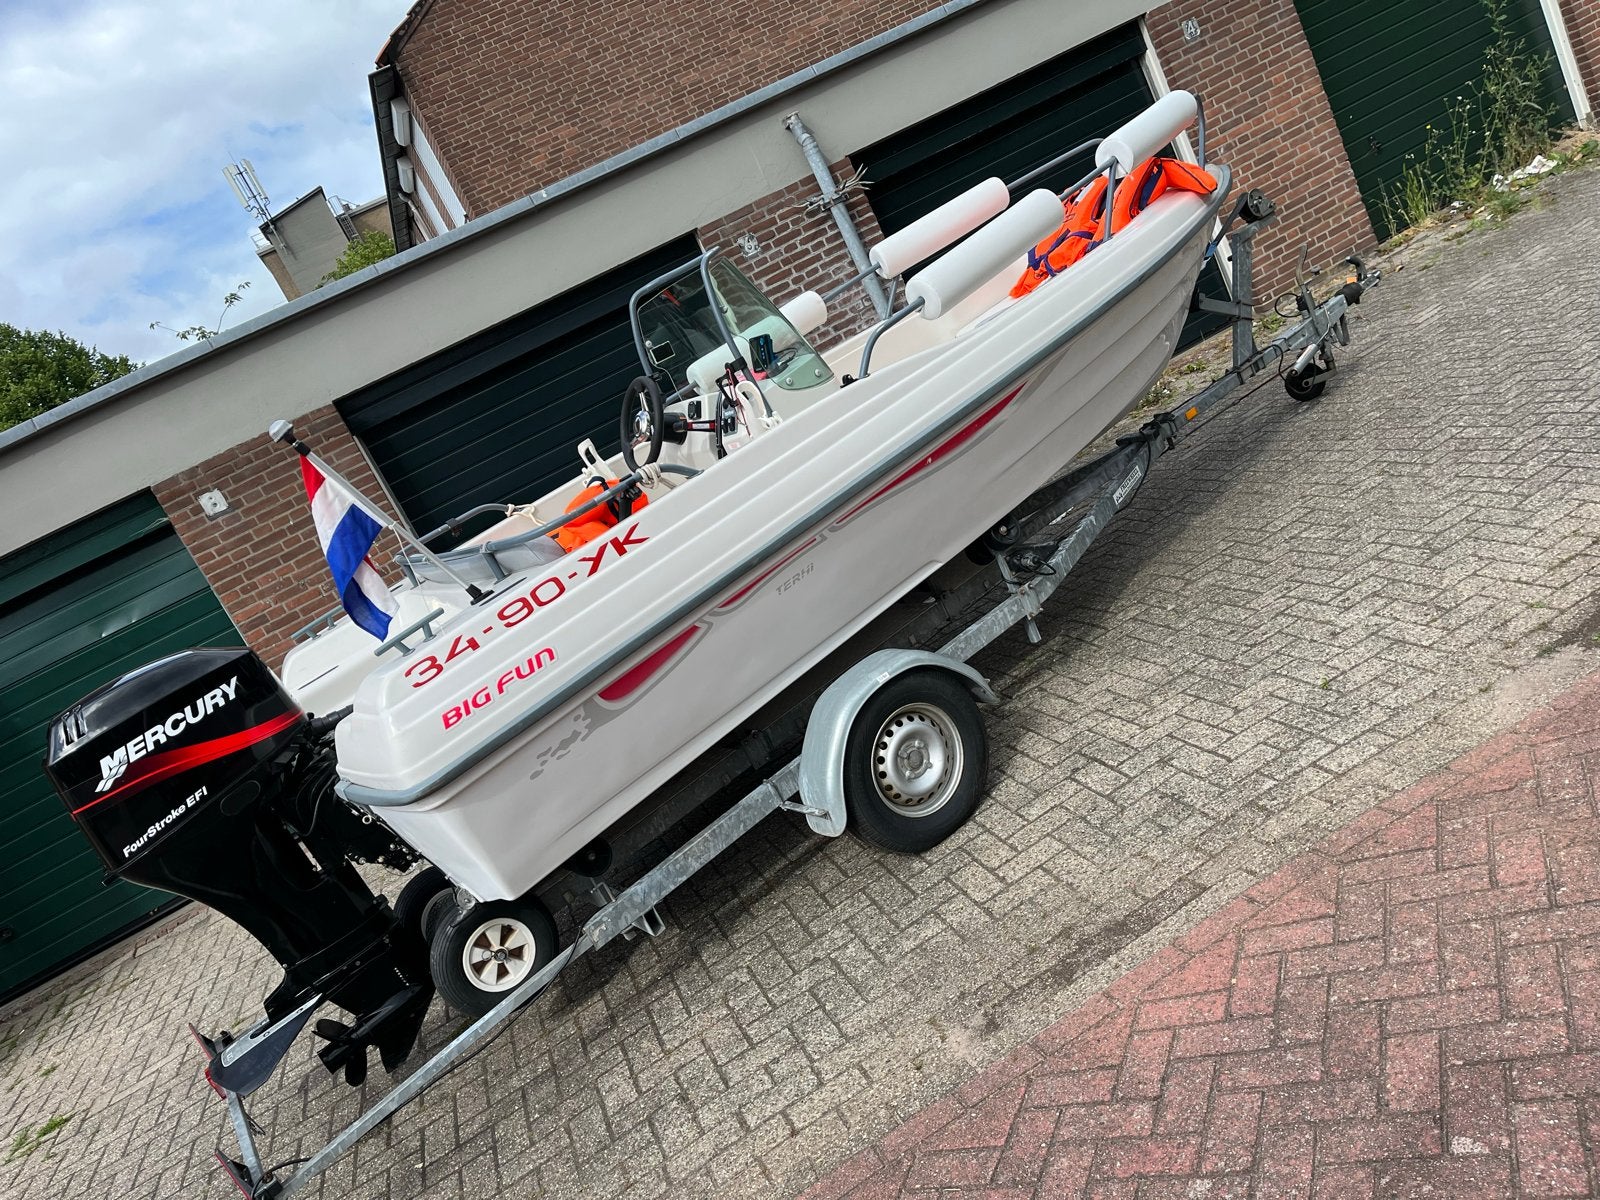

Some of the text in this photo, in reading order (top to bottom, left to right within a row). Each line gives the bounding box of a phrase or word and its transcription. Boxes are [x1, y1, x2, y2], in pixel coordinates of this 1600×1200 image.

[404, 522, 649, 688] 34-90-YK
[95, 675, 238, 793] MERCURY
[441, 686, 492, 730] BIG
[122, 785, 208, 858] FourStroke EFI
